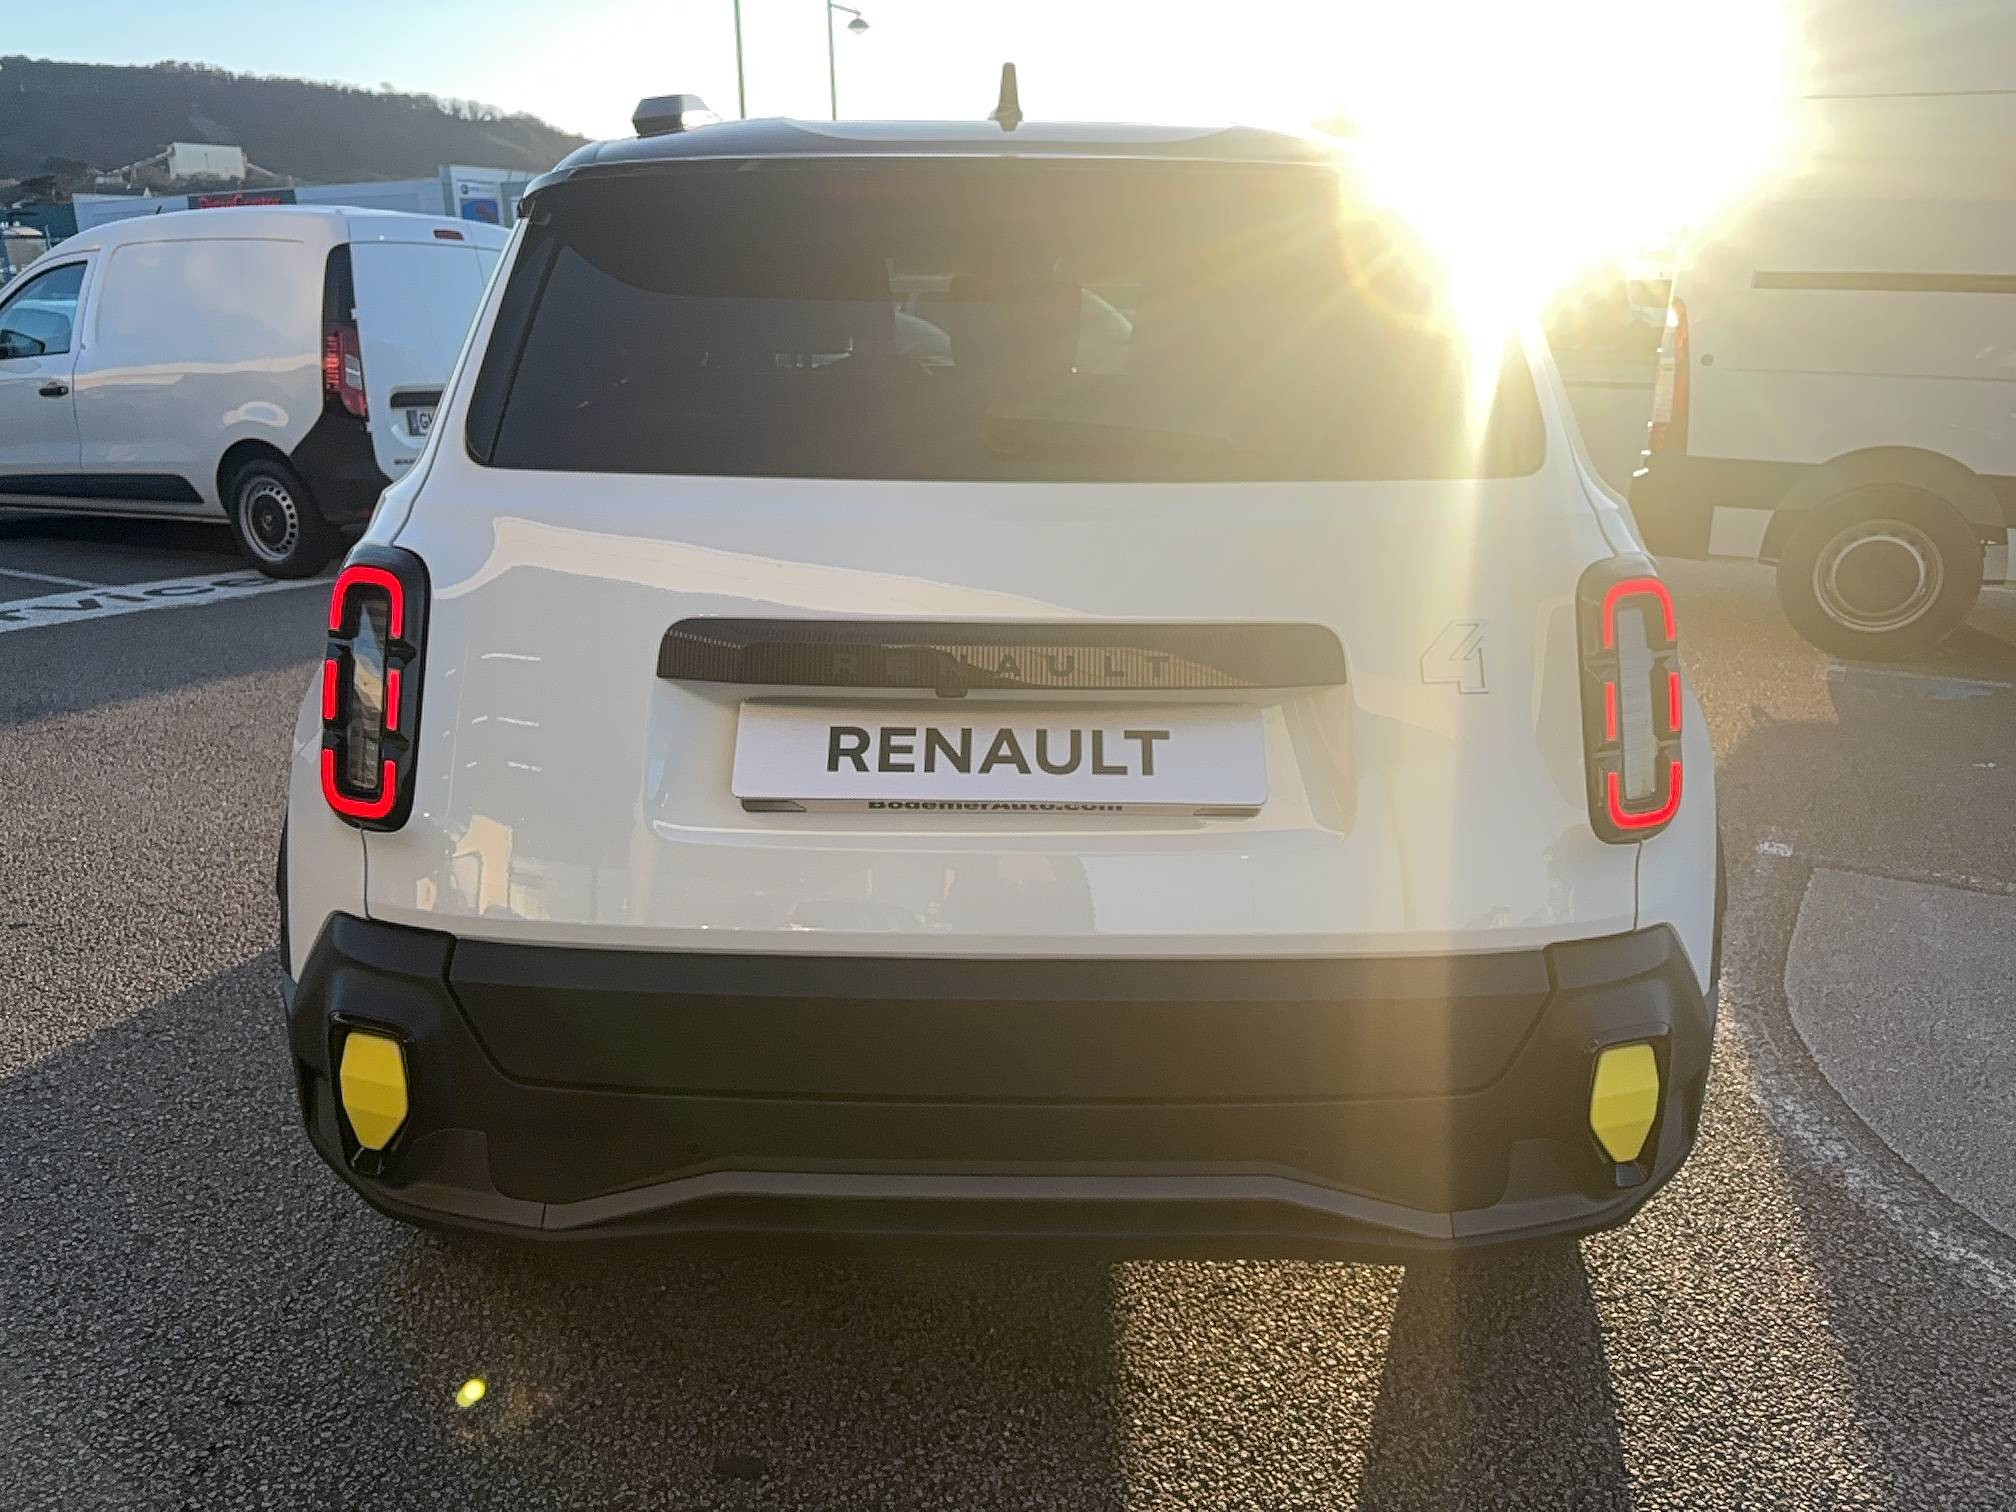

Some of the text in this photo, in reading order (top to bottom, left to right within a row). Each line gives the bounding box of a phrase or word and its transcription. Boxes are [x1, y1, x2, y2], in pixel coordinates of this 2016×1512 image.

[832, 652, 1170, 680] RENAULT
[1419, 619, 1490, 695] 4
[826, 725, 1171, 777] RENAULT
